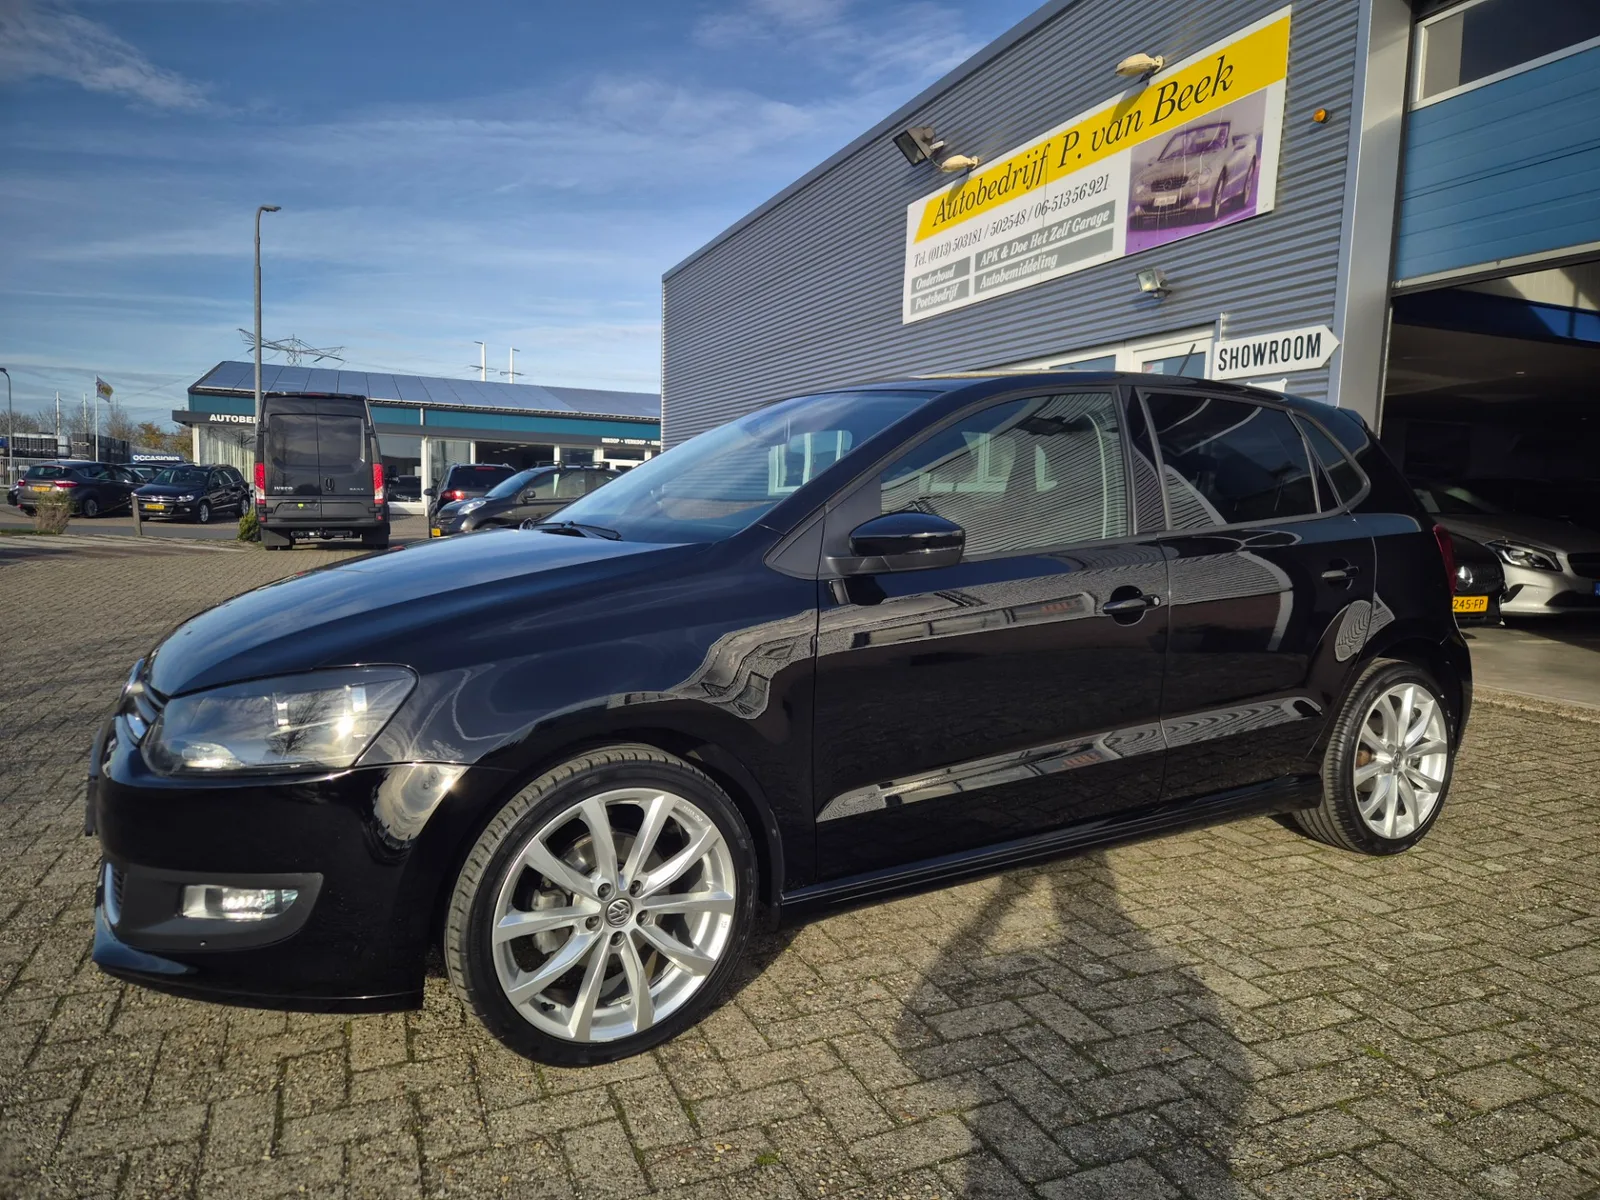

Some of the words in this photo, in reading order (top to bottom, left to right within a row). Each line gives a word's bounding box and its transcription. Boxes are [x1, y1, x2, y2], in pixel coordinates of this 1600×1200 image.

[932, 143, 1051, 227] Autobedrijf
[1057, 131, 1082, 168] P.
[1091, 109, 1144, 153] van
[1150, 54, 1234, 126] Beek
[914, 250, 927, 267] Tel.
[928, 240, 952, 264] (0113)
[952, 228, 982, 253] 503181
[990, 208, 1026, 237] 502548
[980, 248, 1000, 267] APK
[1001, 244, 1009, 259] &
[1010, 239, 1028, 255] Doe
[1030, 230, 1048, 249] Het
[1049, 220, 1072, 242] Zelf
[1072, 209, 1110, 233] Garage
[916, 264, 956, 290] Onderhoud
[980, 254, 1058, 289] Autobemiddeling
[915, 284, 959, 310] Poetsbedrijf
[1218, 332, 1321, 371] SHOWROOM
[132, 454, 180, 462] OCCASIONS
